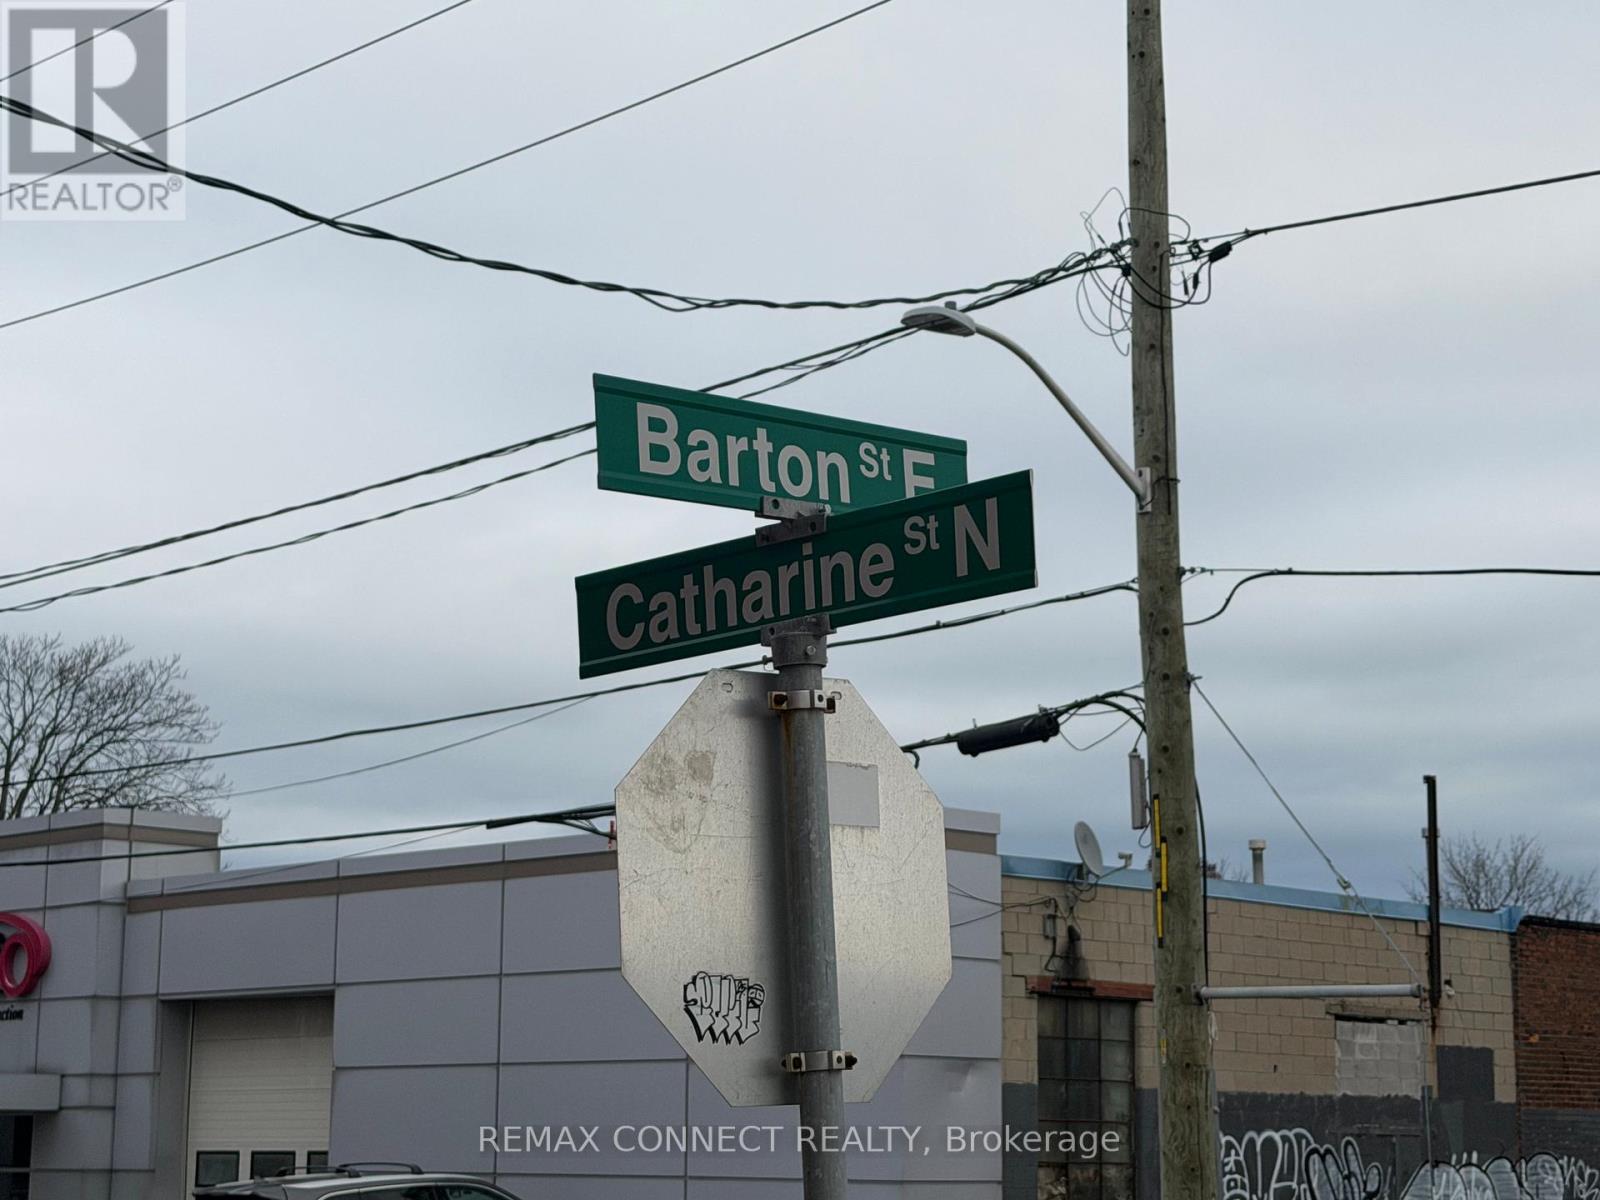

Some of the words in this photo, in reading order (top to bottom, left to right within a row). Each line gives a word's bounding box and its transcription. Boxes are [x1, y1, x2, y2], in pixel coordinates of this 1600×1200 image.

[635, 401, 851, 504] Barton
[858, 441, 893, 482] St
[605, 541, 896, 651] Catharine
[903, 515, 941, 556] St
[953, 496, 1001, 578] N
